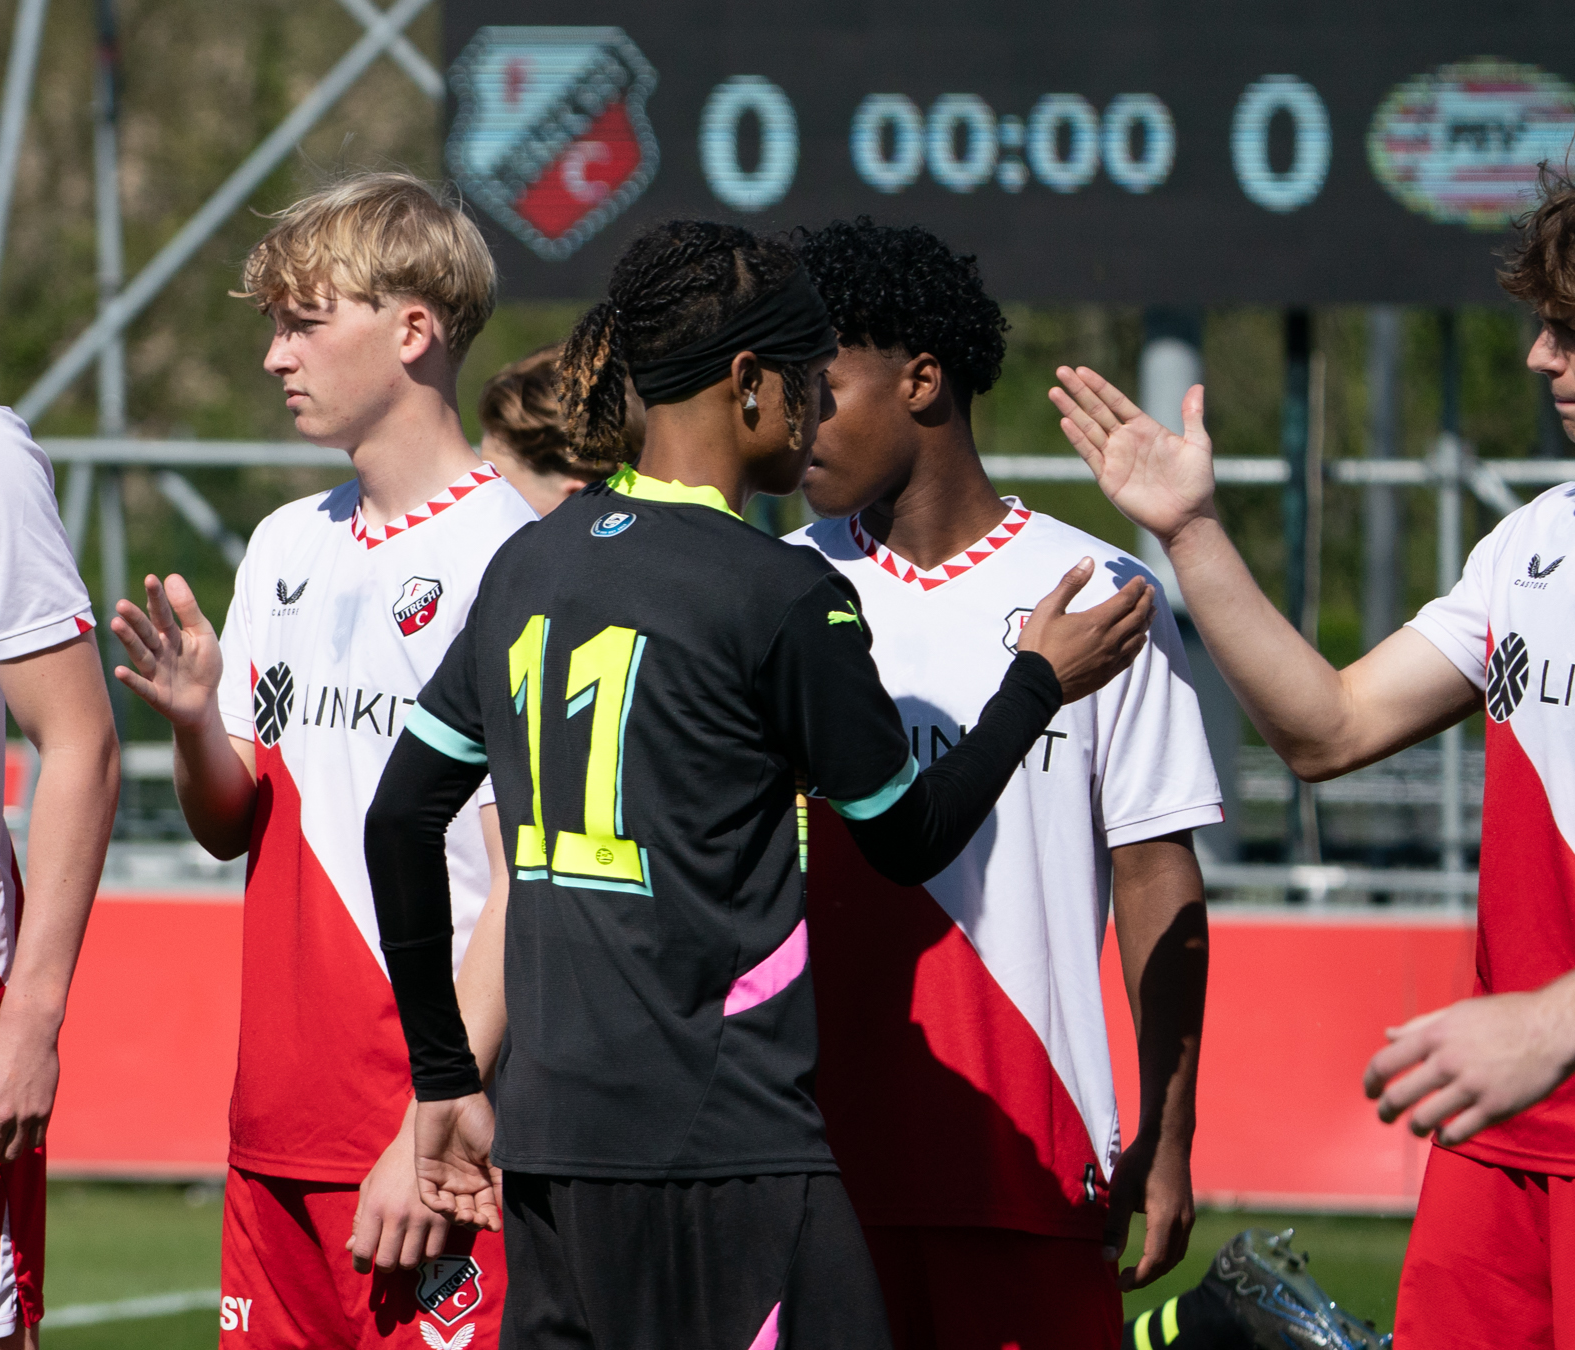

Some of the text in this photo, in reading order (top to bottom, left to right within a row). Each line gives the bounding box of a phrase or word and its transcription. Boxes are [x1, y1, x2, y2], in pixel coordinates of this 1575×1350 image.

[698, 74, 799, 213] 0
[849, 92, 1174, 194] 00:00
[1230, 73, 1332, 214] 0
[561, 141, 611, 202] C
[395, 585, 441, 623] UTRECHT
[410, 582, 422, 597] F
[1514, 579, 1549, 590] CASTORE
[415, 610, 429, 626] C
[508, 613, 654, 898] 11
[426, 1263, 475, 1309] UTRECHT
[452, 1291, 468, 1308] C
